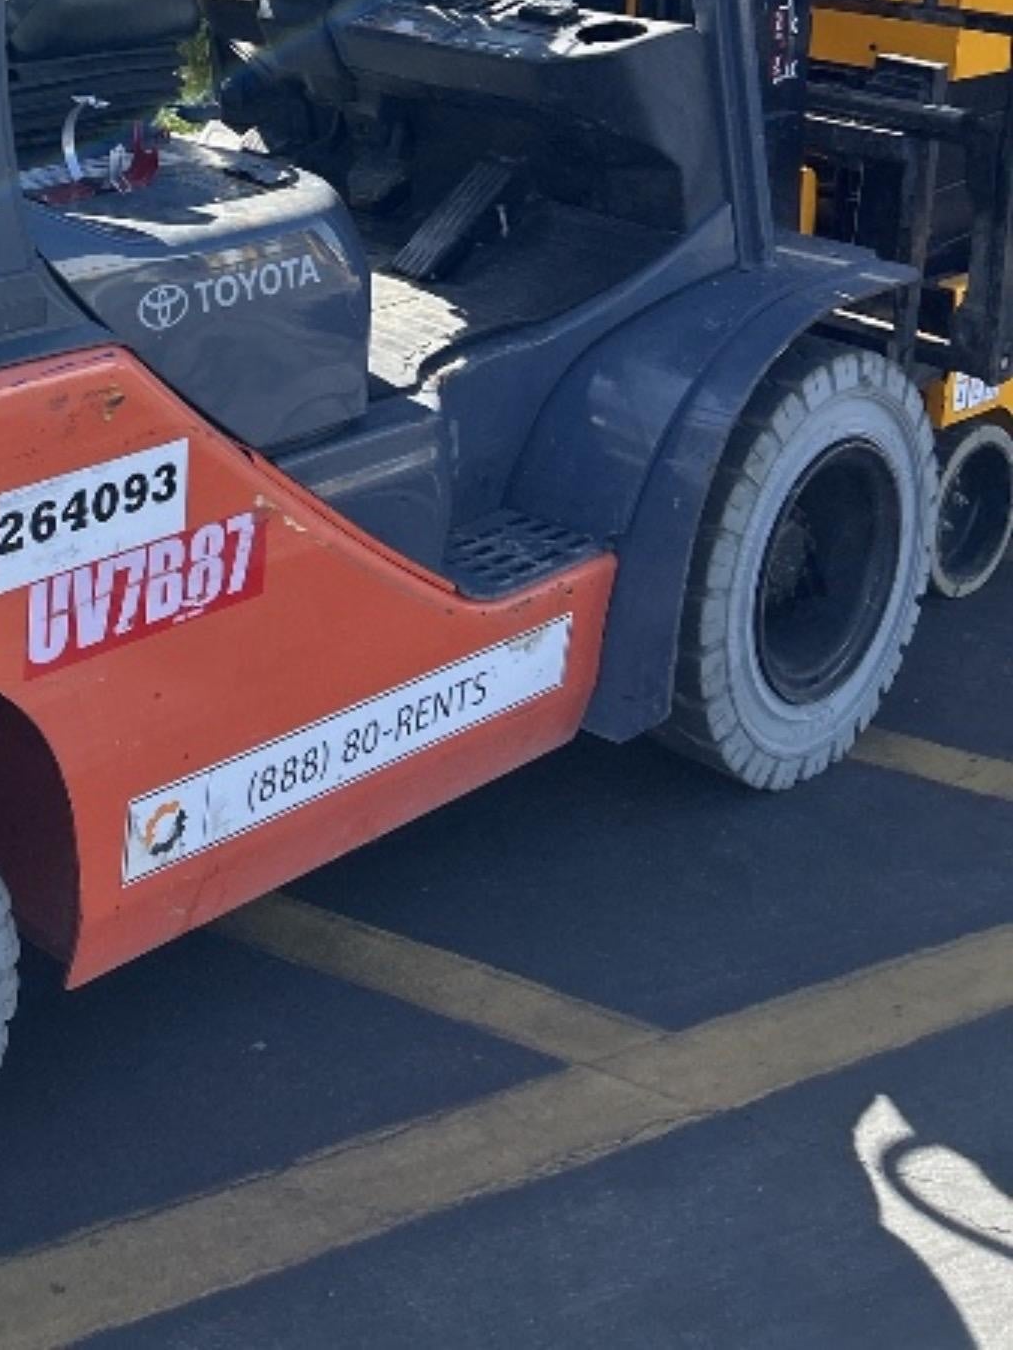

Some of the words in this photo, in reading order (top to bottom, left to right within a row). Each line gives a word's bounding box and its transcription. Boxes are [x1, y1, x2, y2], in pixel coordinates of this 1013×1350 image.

[193, 254, 321, 314] TOYOTA
[246, 739, 331, 812] (888)
[341, 670, 489, 765] 80-RENTS
